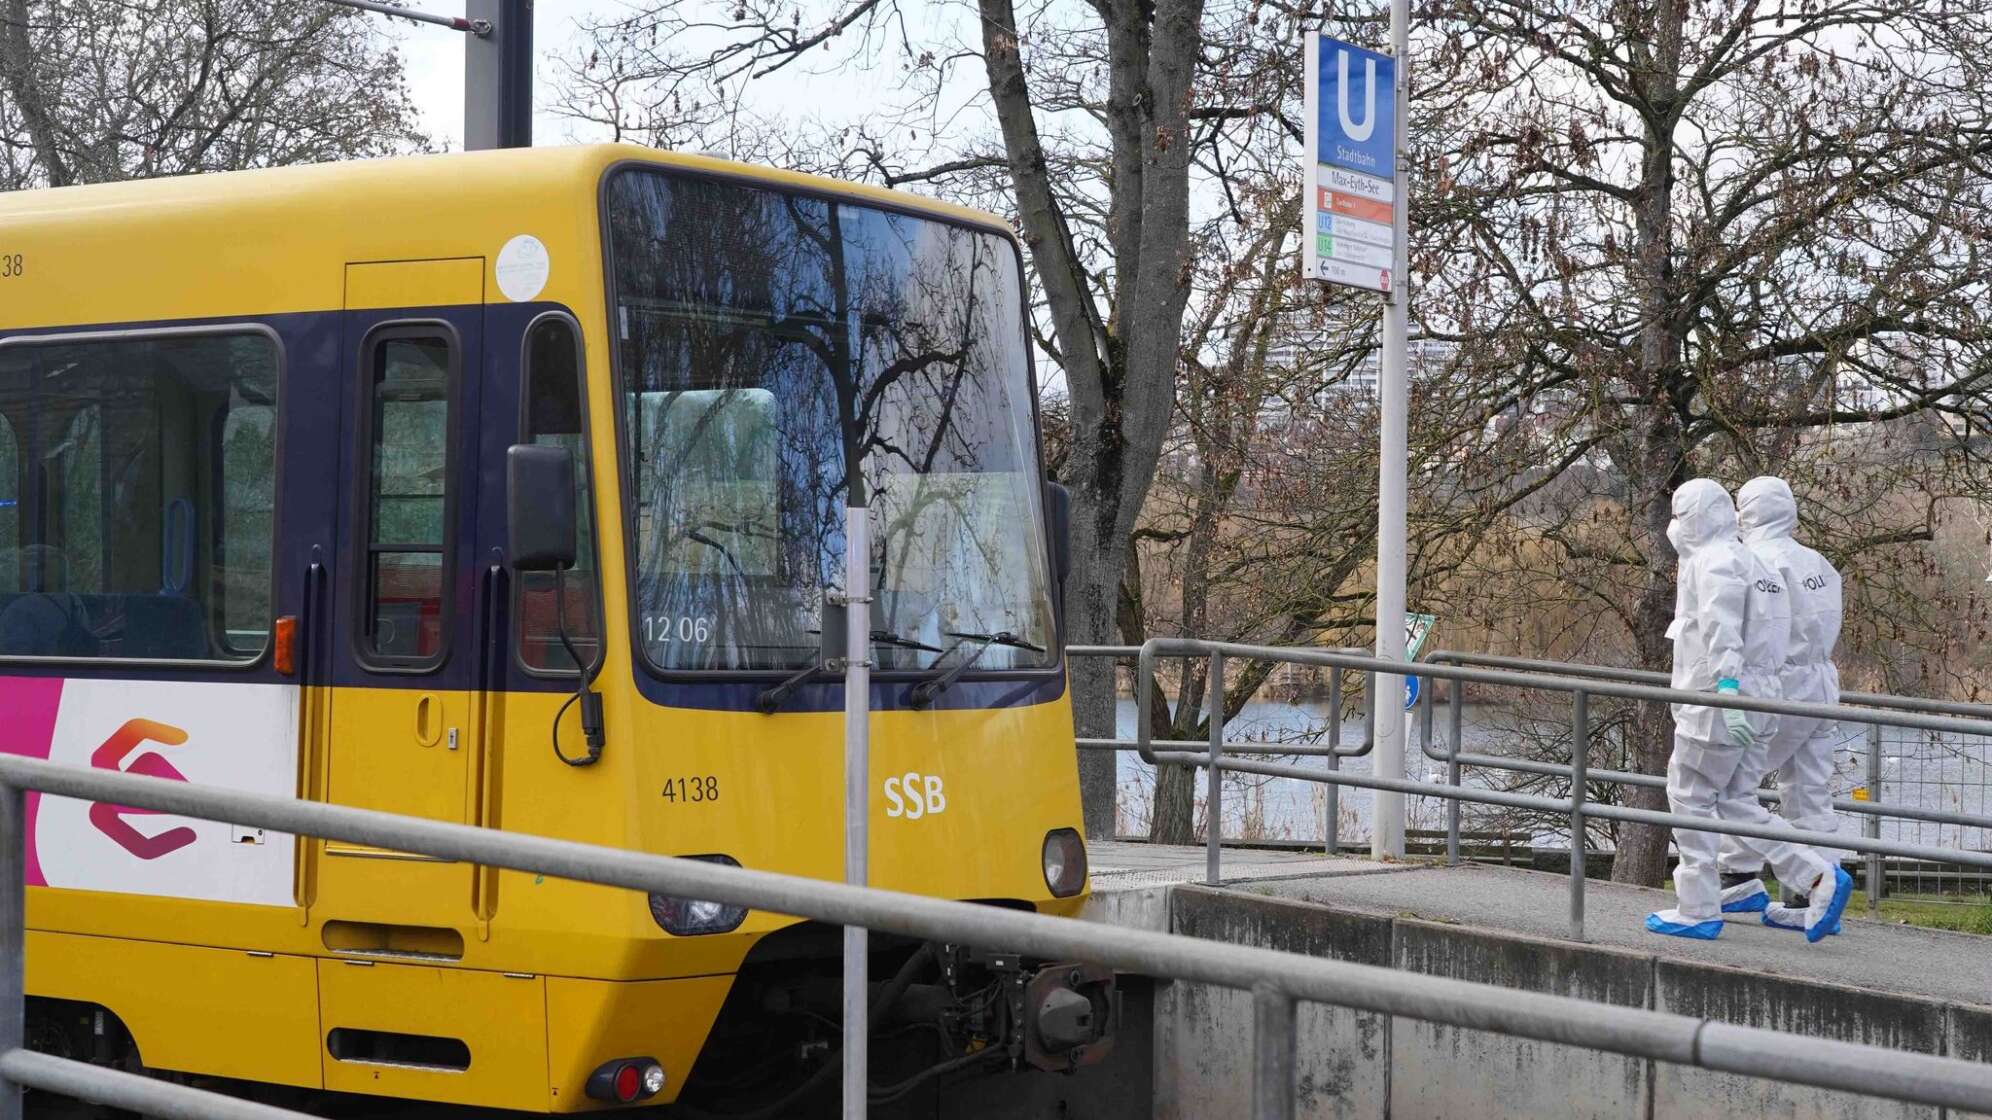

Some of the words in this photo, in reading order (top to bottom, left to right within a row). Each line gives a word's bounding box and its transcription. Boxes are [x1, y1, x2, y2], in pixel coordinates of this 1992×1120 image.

[1338, 49, 1376, 142] U
[1337, 145, 1376, 168] Stadtbahn
[1332, 171, 1380, 194] Max-Eyth-See
[1317, 237, 1333, 252] U14
[645, 616, 670, 641] 12
[680, 617, 708, 642] 06
[662, 775, 719, 803] 4138
[884, 772, 946, 819] SSB
